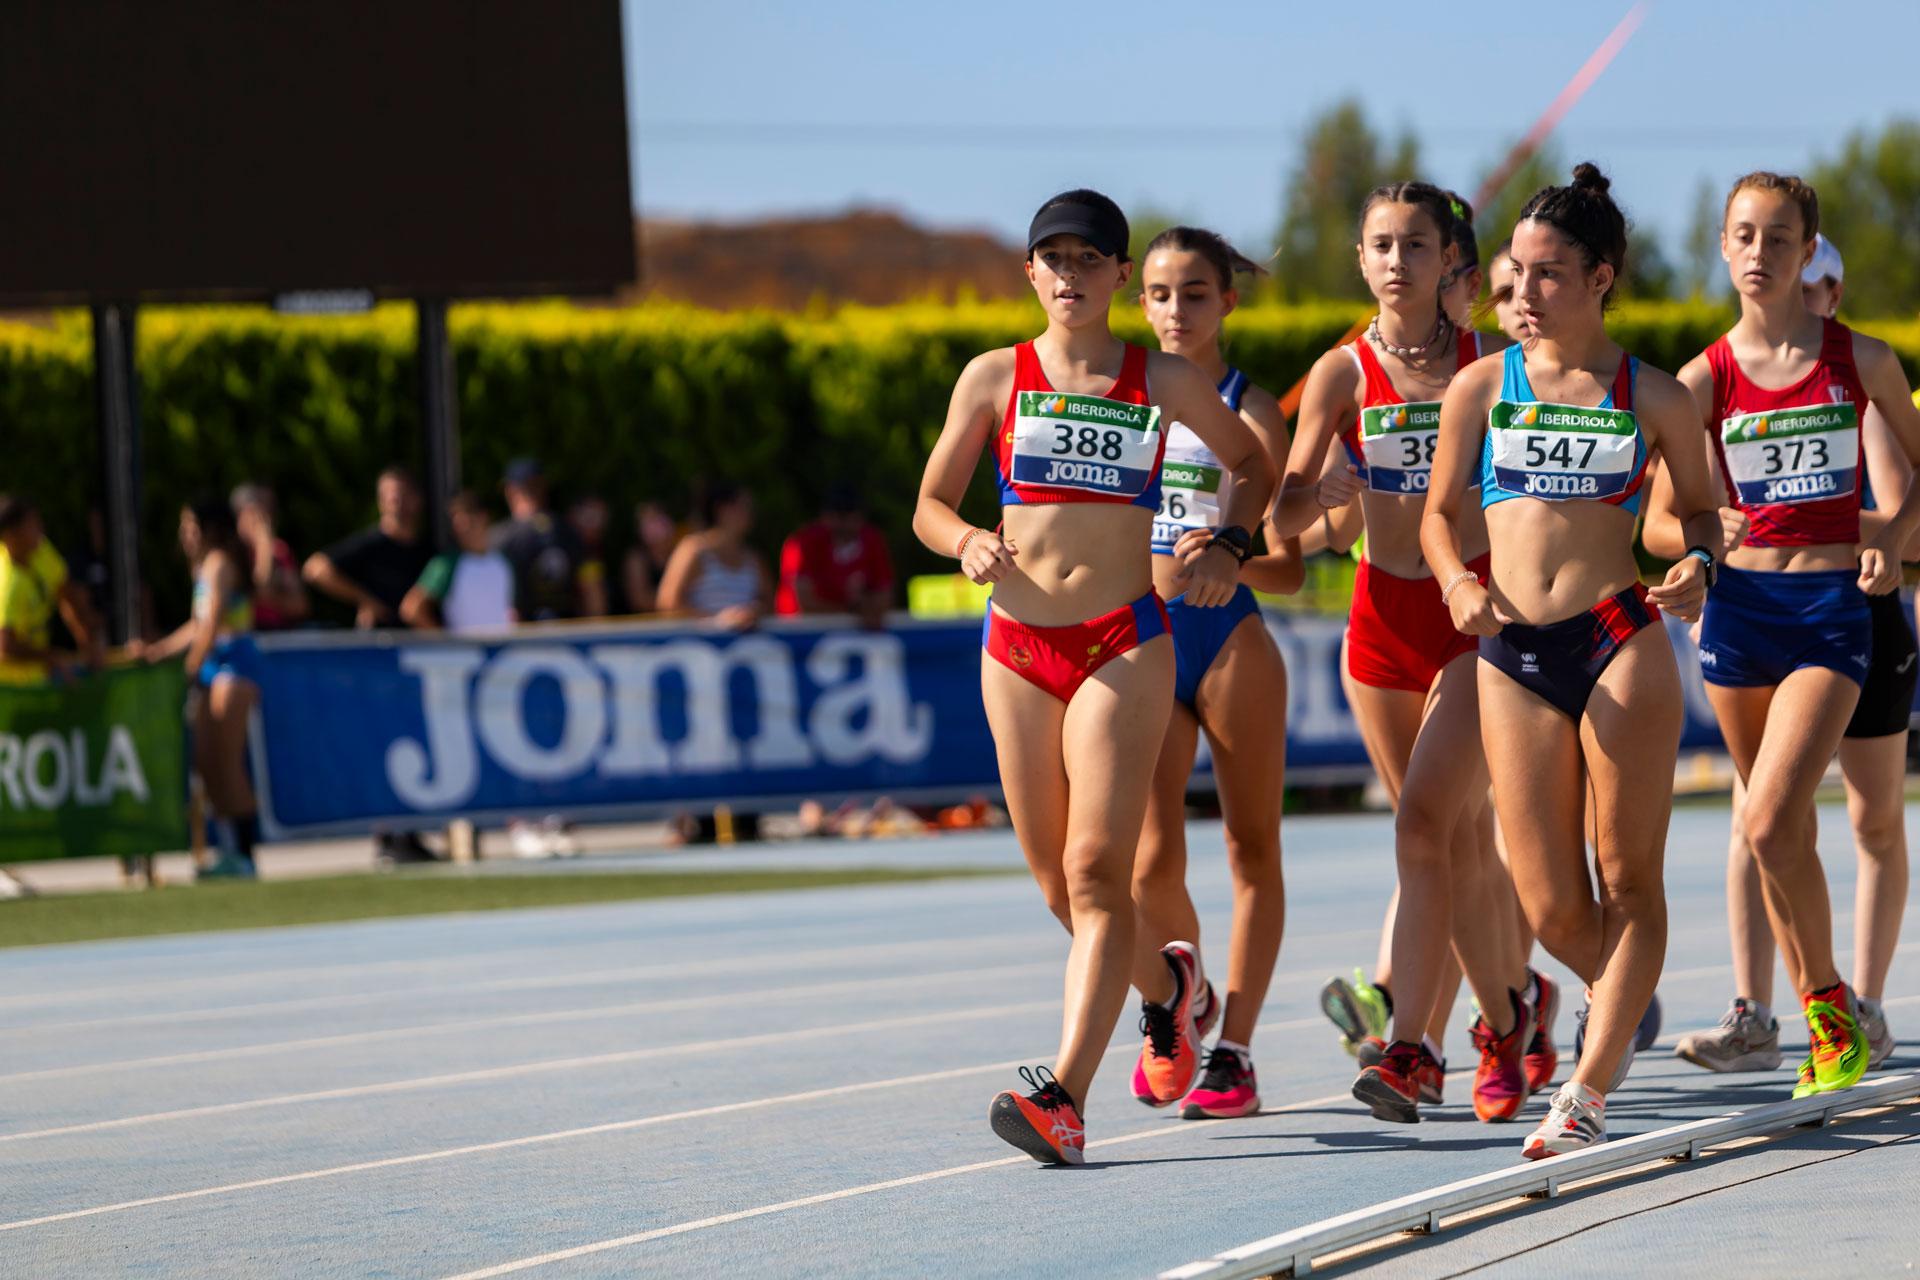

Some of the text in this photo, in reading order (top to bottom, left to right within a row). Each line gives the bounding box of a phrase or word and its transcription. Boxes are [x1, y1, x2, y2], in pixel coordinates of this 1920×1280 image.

[1068, 402, 1142, 424] IBERDROLA
[1539, 413, 1618, 429] IBERDROLA
[1769, 413, 1842, 432] IBERDROLA
[1050, 424, 1124, 461] 388
[1525, 435, 1598, 469] 547
[1761, 438, 1830, 474] 373
[386, 634, 933, 809] Joma
